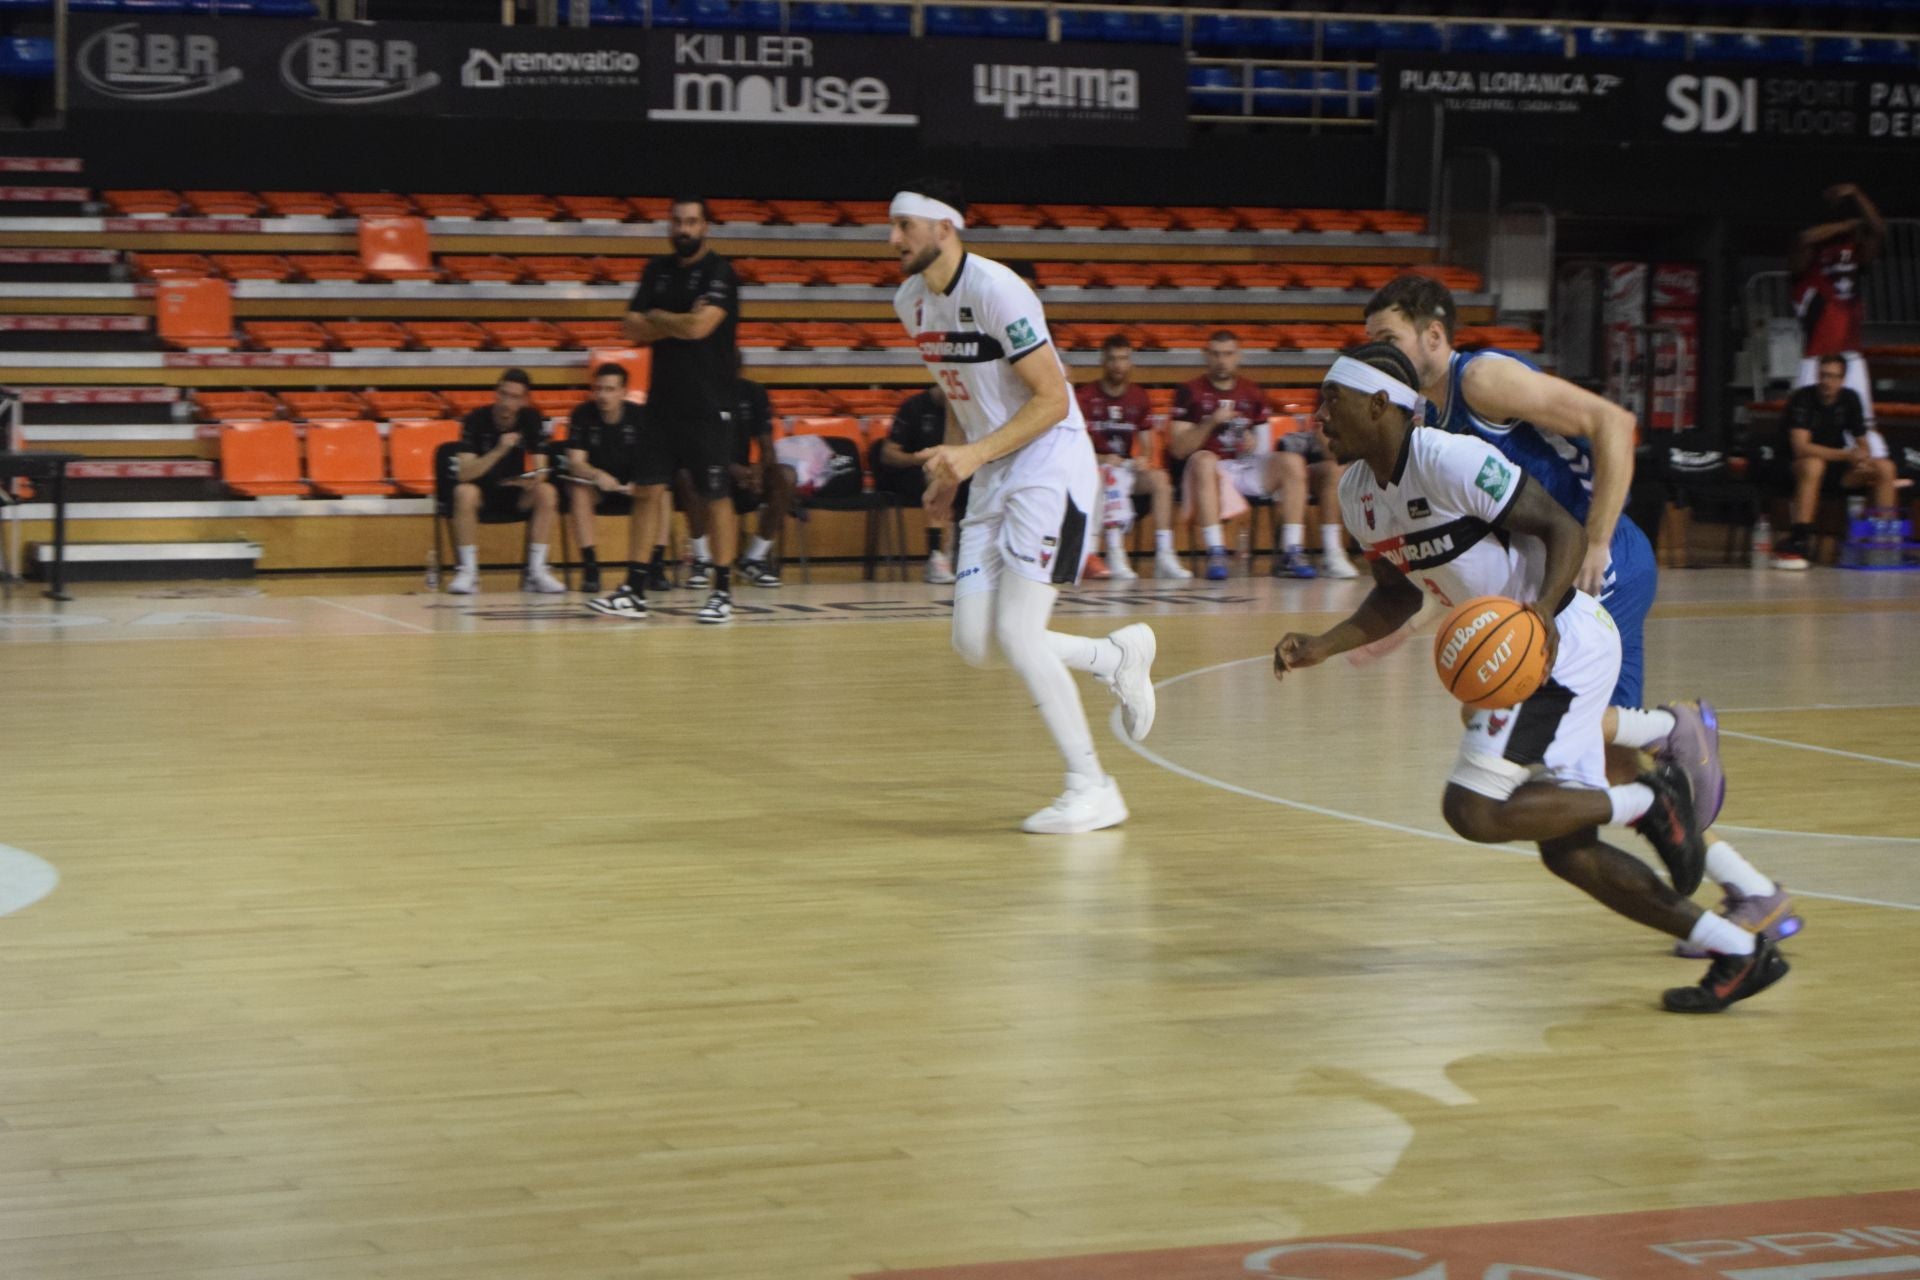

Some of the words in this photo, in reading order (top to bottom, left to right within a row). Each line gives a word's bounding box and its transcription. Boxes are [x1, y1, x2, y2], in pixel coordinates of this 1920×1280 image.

[675, 33, 813, 66] KILLER
[973, 63, 1139, 118] upama
[1400, 69, 1475, 91] PLAZA
[1763, 78, 1858, 105] SPORT
[1662, 74, 1757, 133] SDI
[1763, 109, 1857, 134] FLOOR
[1440, 609, 1500, 670] Wilson
